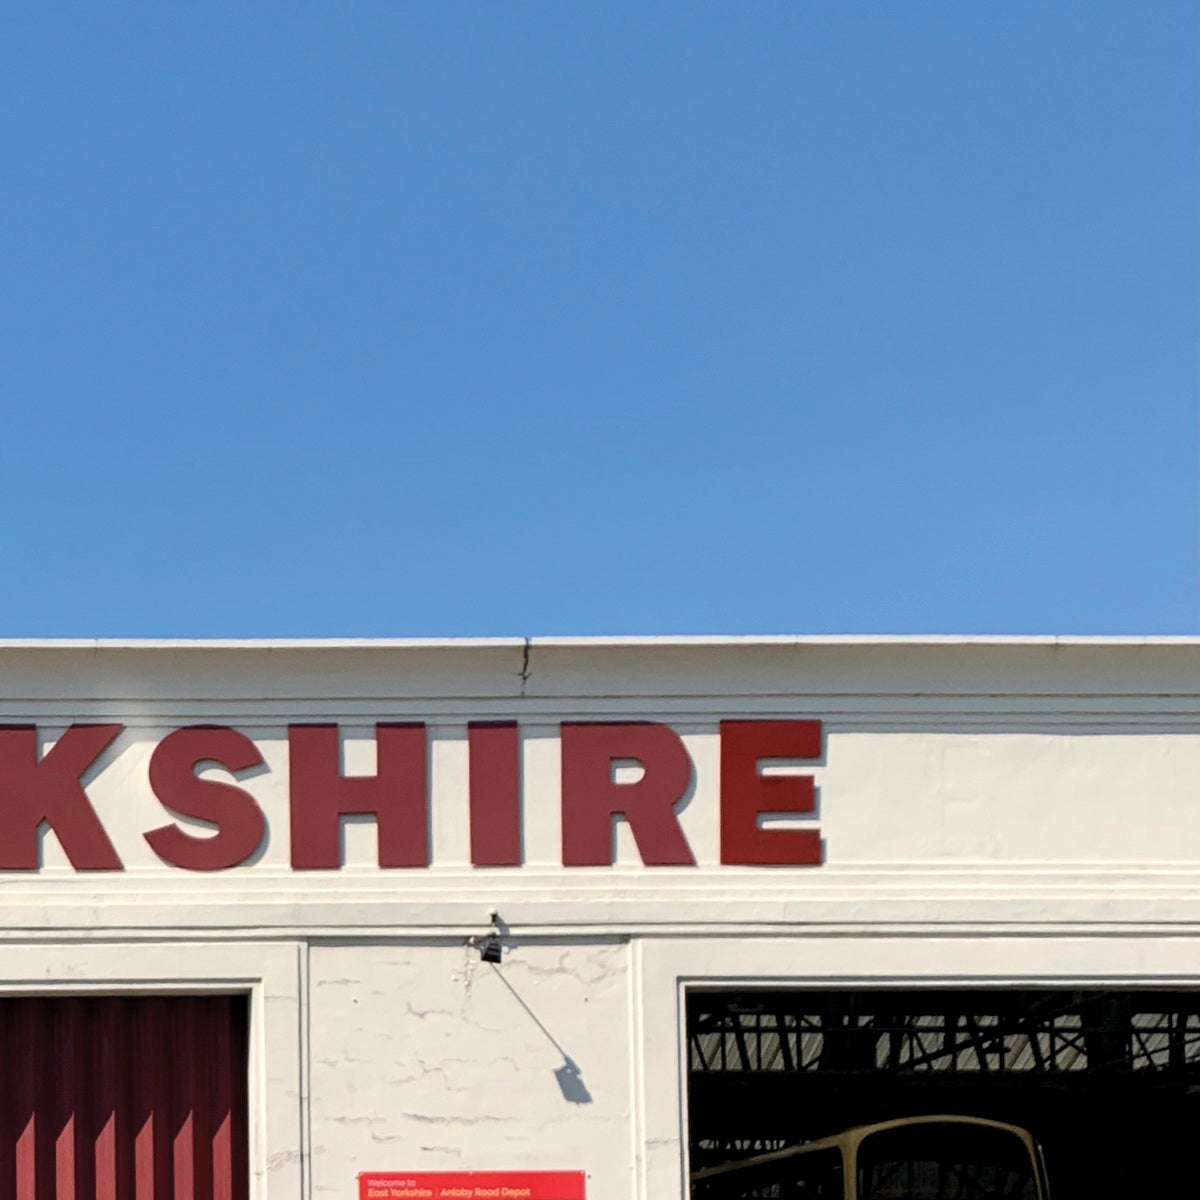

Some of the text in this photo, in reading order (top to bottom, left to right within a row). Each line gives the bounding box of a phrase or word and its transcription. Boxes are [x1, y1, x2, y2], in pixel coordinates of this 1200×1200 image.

[367, 1179, 416, 1187] Welcome to
[367, 1186, 532, 1199] East Yorkshire Anlaby Road Depot
